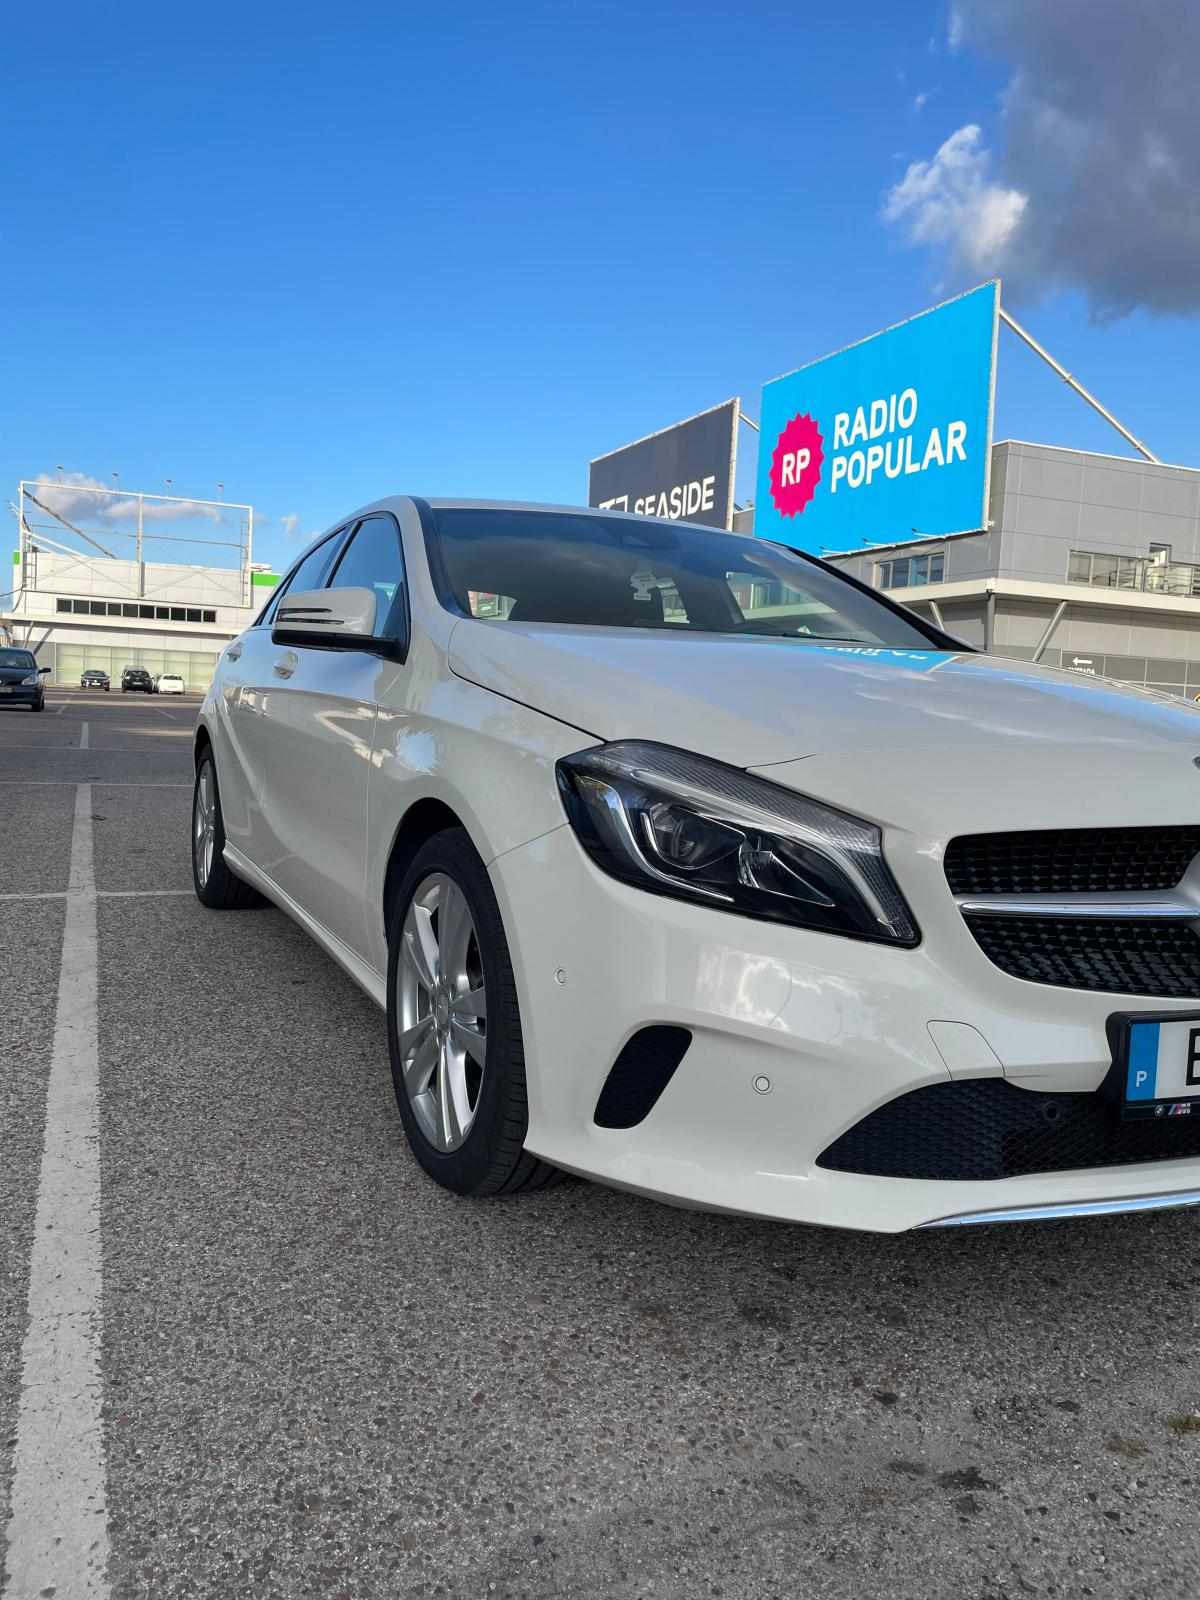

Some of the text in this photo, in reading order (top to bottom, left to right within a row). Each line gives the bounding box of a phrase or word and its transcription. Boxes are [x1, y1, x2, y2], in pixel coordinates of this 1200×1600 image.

[833, 388, 917, 450] RADIO
[781, 448, 810, 487] RP
[831, 420, 967, 493] POPULAR
[634, 475, 715, 520] SEASIDE
[1135, 1070, 1148, 1088] P
